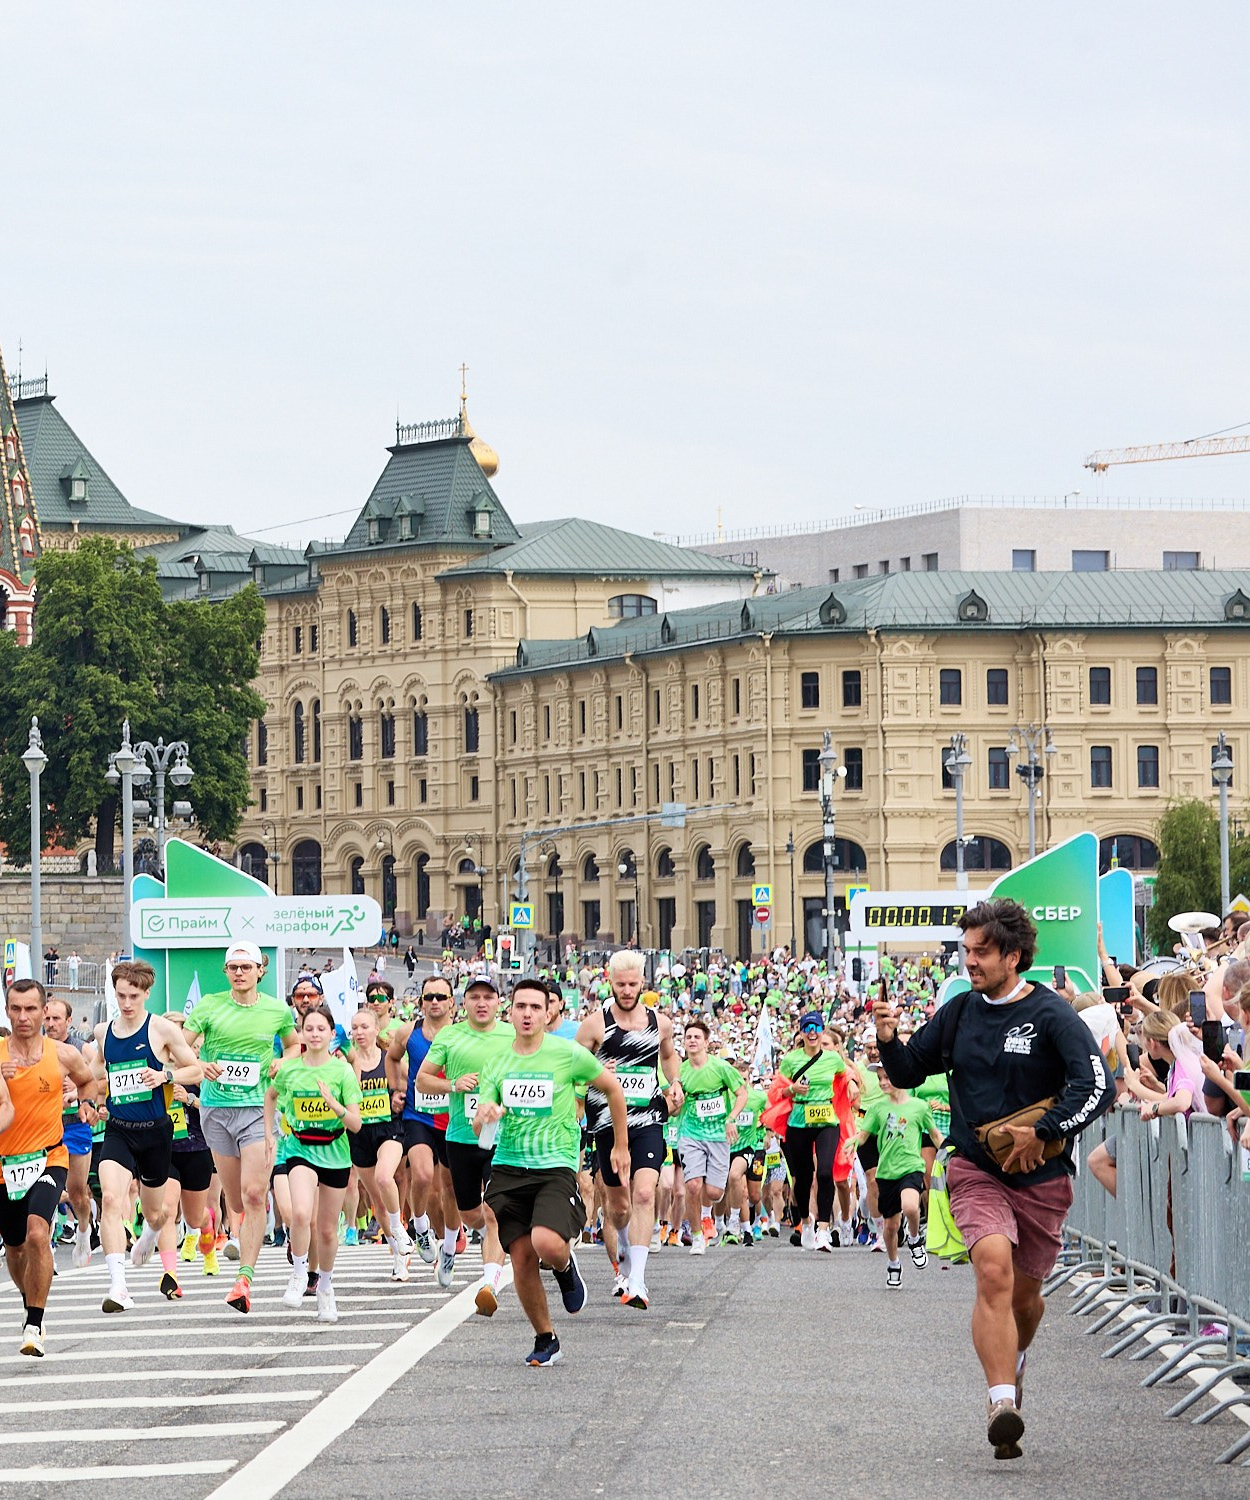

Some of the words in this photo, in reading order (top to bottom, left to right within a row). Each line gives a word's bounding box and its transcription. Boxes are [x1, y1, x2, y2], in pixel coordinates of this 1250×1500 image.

[273, 906, 334, 919] зелёный
[1032, 906, 1082, 921] СБЕР
[168, 916, 218, 931] Прайм
[265, 919, 329, 933] марафон
[227, 1065, 250, 1078] 969
[115, 1072, 144, 1088] 3713
[509, 1084, 545, 1098] 4765
[111, 1116, 132, 1128] NIKE
[132, 1120, 155, 1129] PRO
